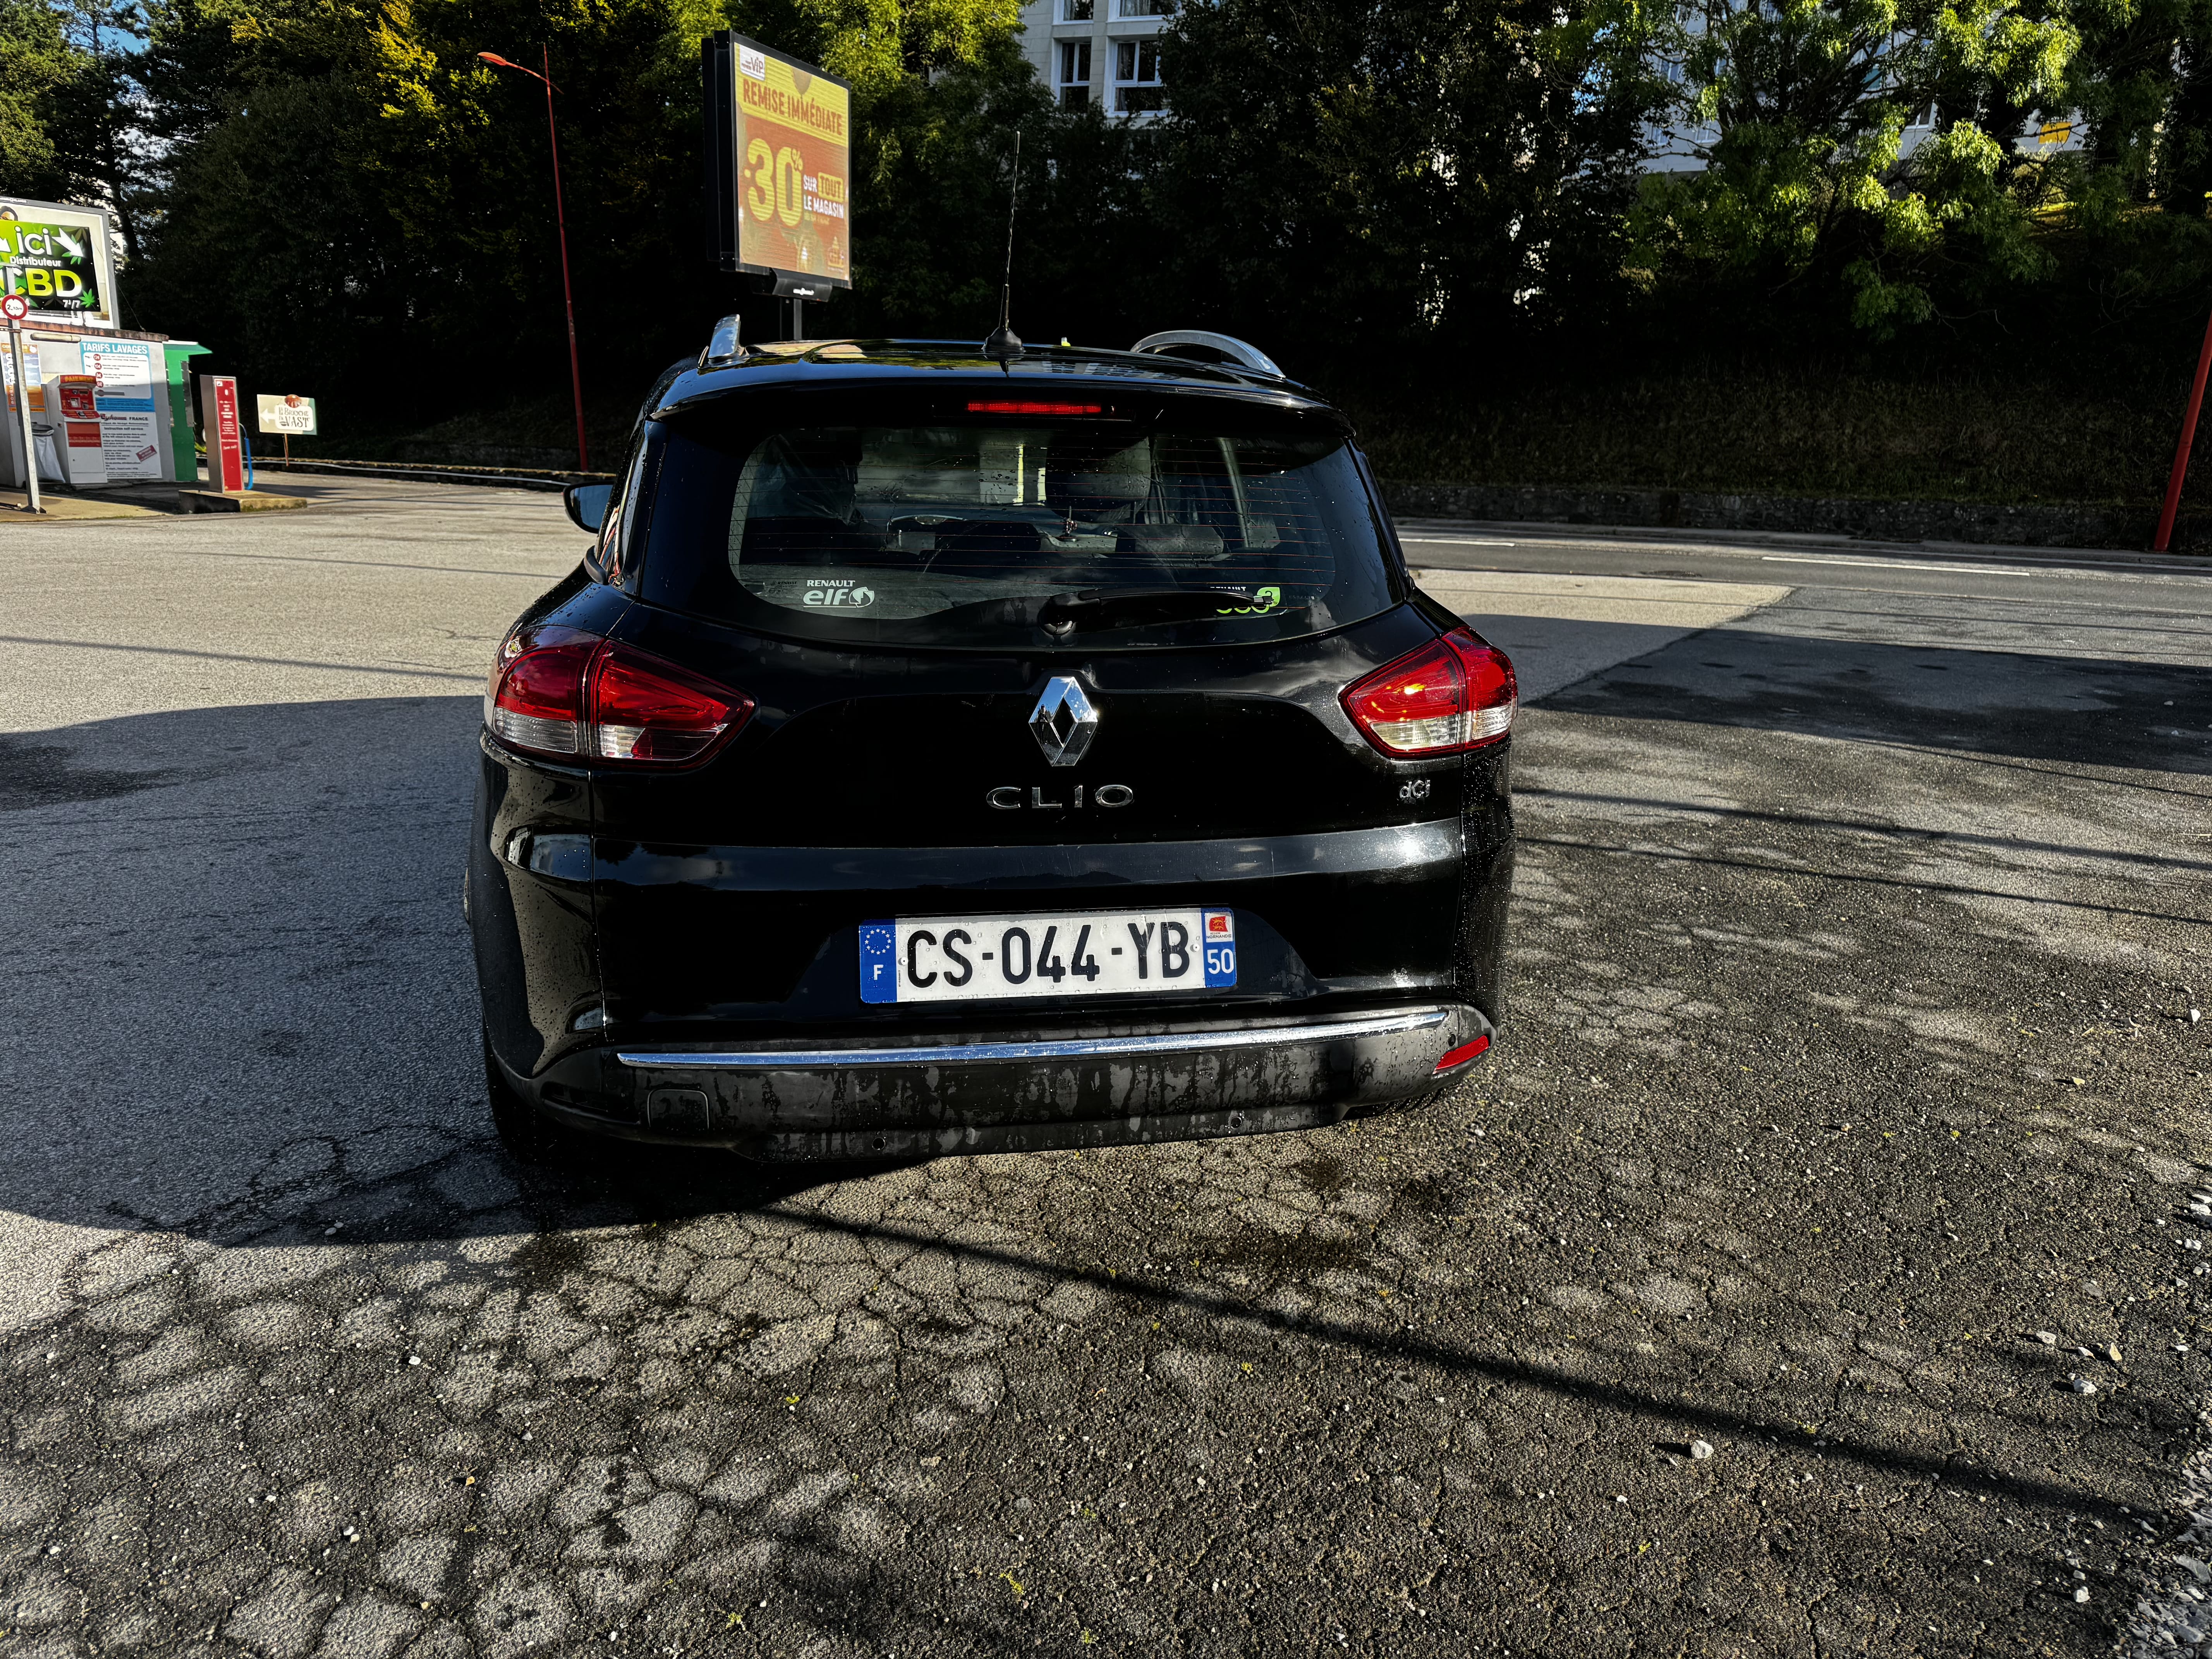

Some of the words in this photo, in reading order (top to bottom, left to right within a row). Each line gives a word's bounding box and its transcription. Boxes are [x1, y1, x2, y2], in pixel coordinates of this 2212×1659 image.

[743, 79, 785, 115] REMISE
[787, 95, 842, 136] IMMÉDIATE
[804, 174, 817, 192] SUR
[820, 175, 842, 199] TOUT
[804, 194, 812, 211] LE
[813, 198, 844, 219] MAGASIN
[14, 225, 53, 256] ici
[10, 256, 62, 267] Distributeur
[82, 343, 110, 352] TARIFS
[112, 344, 148, 354] LAVAGES
[285, 416, 310, 428] VAST
[803, 589, 849, 605] elf
[986, 784, 1133, 809] CLIO
[874, 964, 883, 980] F
[907, 921, 1190, 988] CS-044-YB
[1207, 948, 1234, 974] 50
